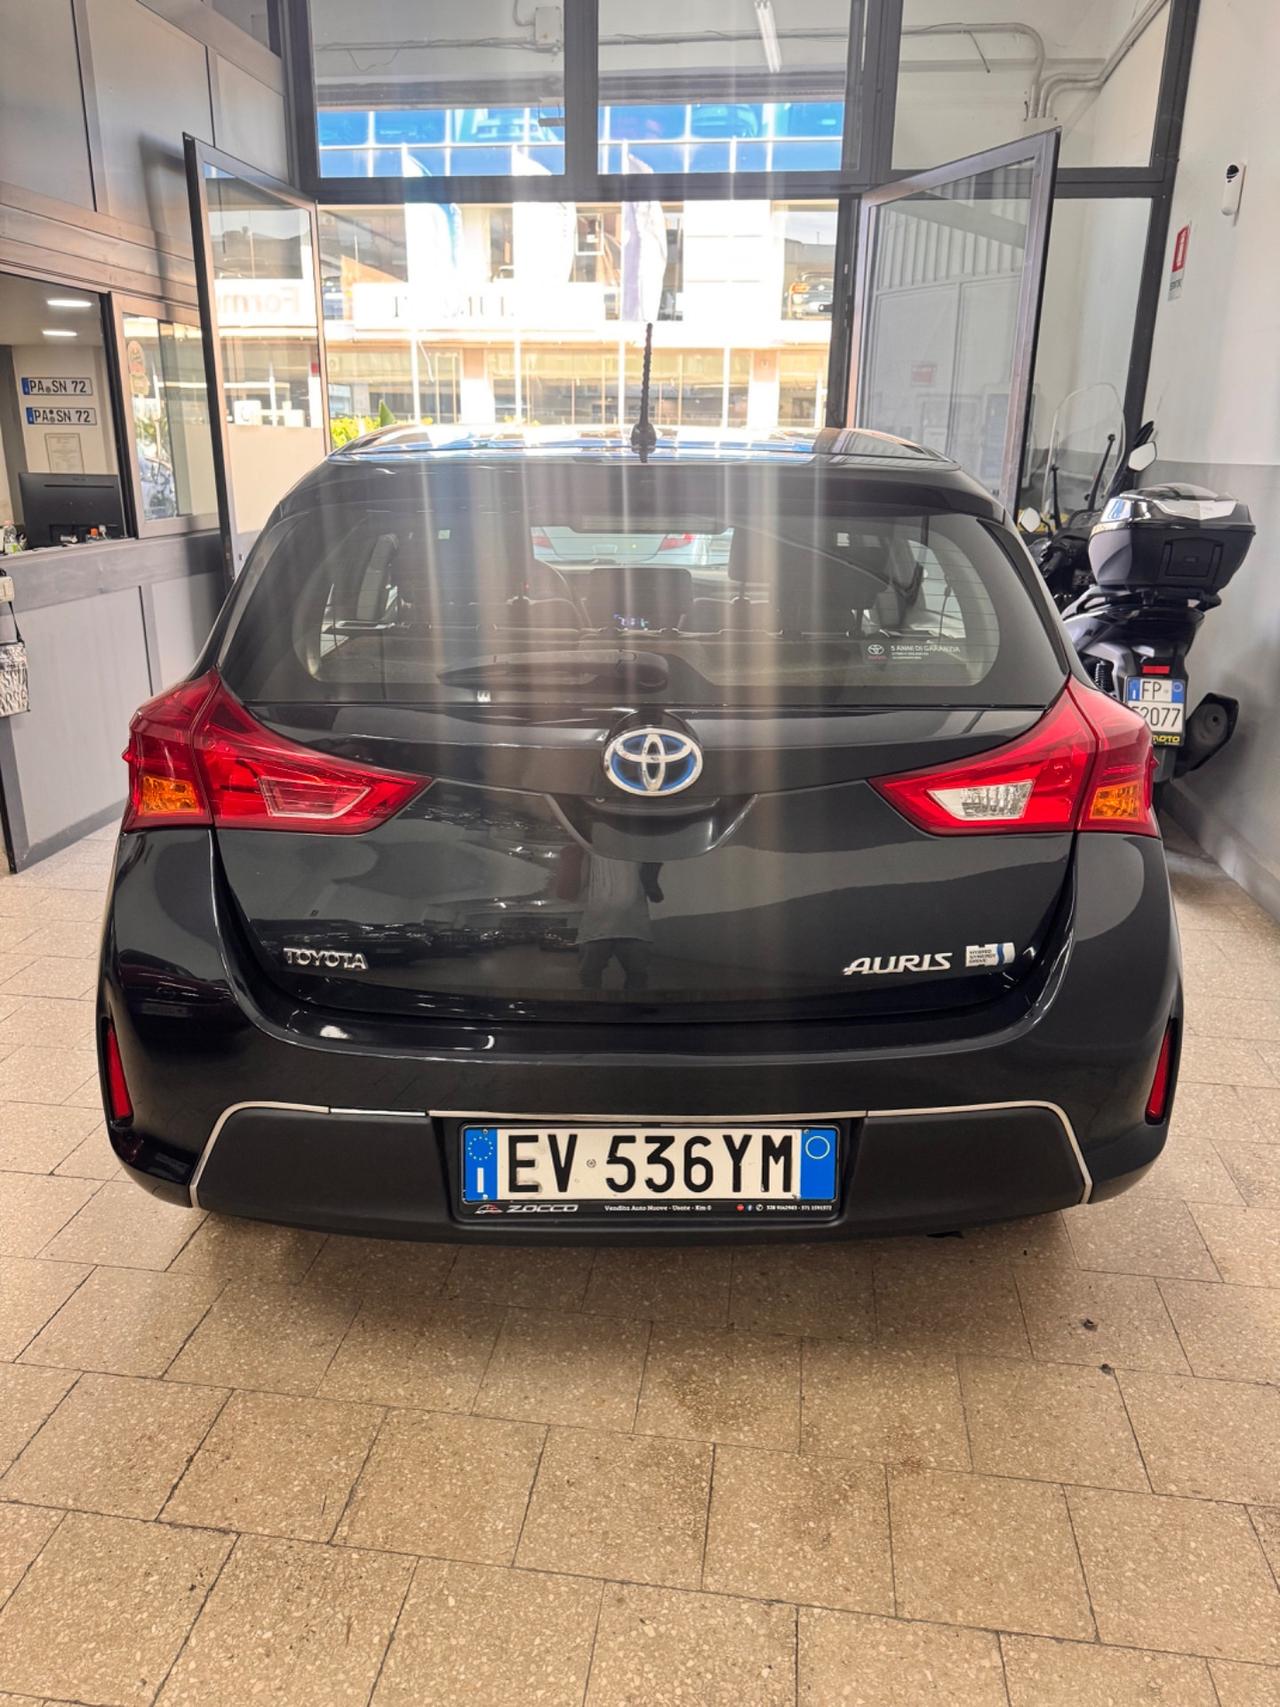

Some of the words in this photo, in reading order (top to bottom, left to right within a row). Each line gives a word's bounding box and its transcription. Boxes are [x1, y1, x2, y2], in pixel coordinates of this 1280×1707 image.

[30, 380, 45, 393] PA
[52, 380, 67, 393] SN
[71, 380, 87, 393] 72
[34, 409, 49, 422] PA
[57, 410, 71, 422] SN
[76, 410, 91, 423] 72
[1142, 680, 1162, 700] FP
[283, 947, 369, 970] TOYOTA
[842, 952, 953, 976] AURIS
[507, 1134, 578, 1193] EV
[605, 1134, 794, 1194] 536YM
[506, 1204, 579, 1214] ZOCCO
